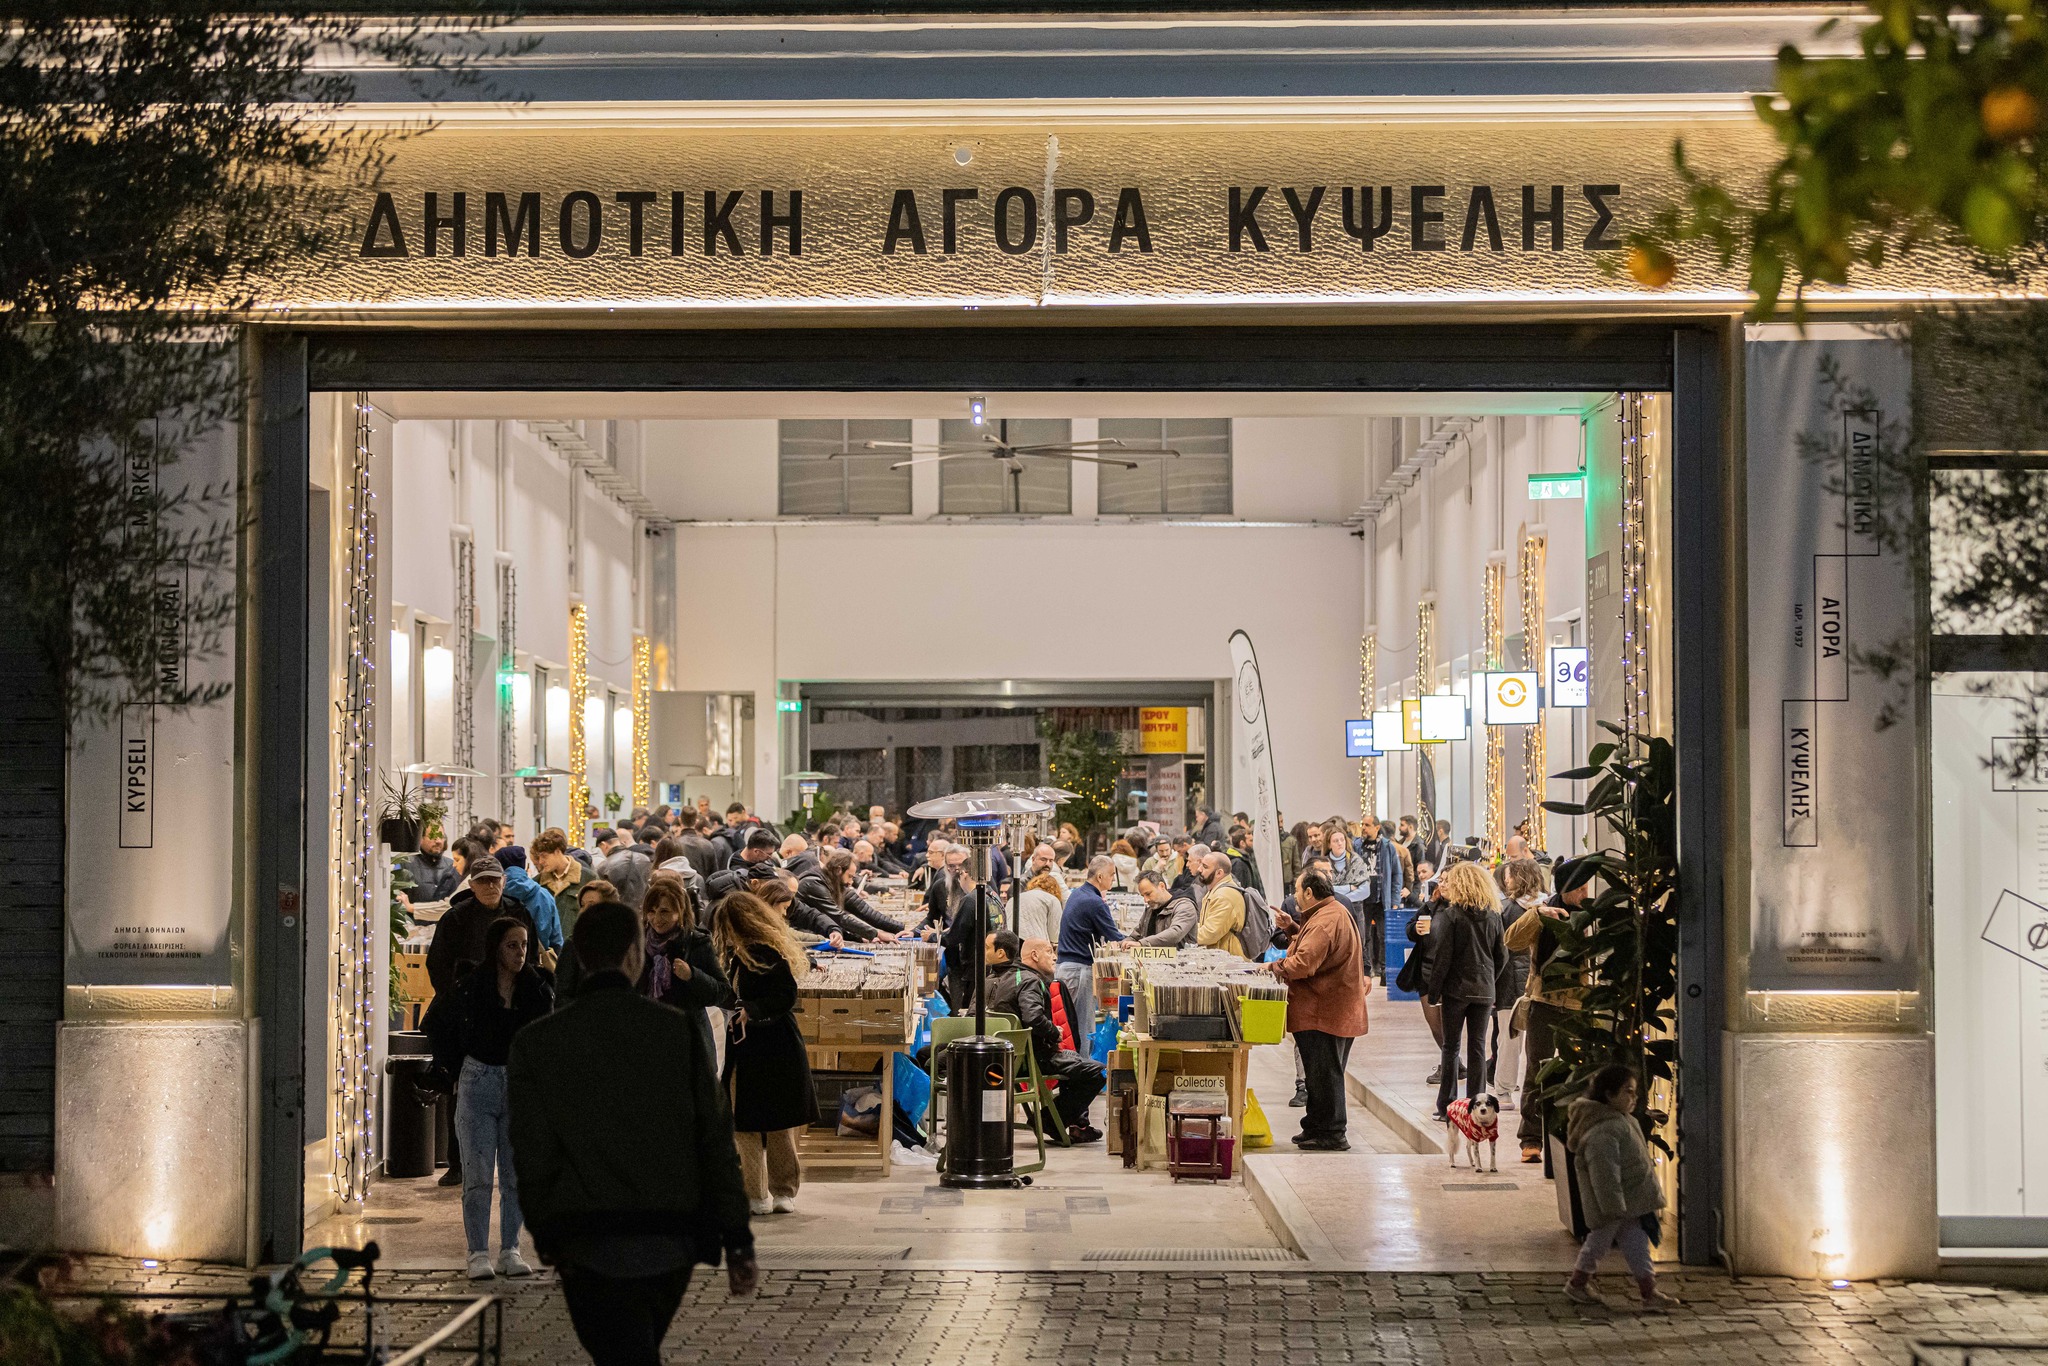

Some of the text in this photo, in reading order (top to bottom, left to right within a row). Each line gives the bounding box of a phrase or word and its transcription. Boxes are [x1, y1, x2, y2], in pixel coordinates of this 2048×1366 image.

[359, 184, 1624, 258] ΔΗΜΟΤΙΚΗ ΑΓΟΡΑ ΚΥΨΕΛΗΣ
[1794, 626, 1803, 648] 1937
[1822, 597, 1840, 659] ΑΓΟΡΑ
[127, 739, 146, 813] KYPSELI
[1791, 728, 1810, 819] ΚΥΨΕΛΗΣ
[114, 926, 186, 934] ΔΗΜΟΣ ΑΘΗΝΑΙΩΝ
[1133, 948, 1174, 959] METAL
[1175, 1076, 1225, 1088] Collector's
